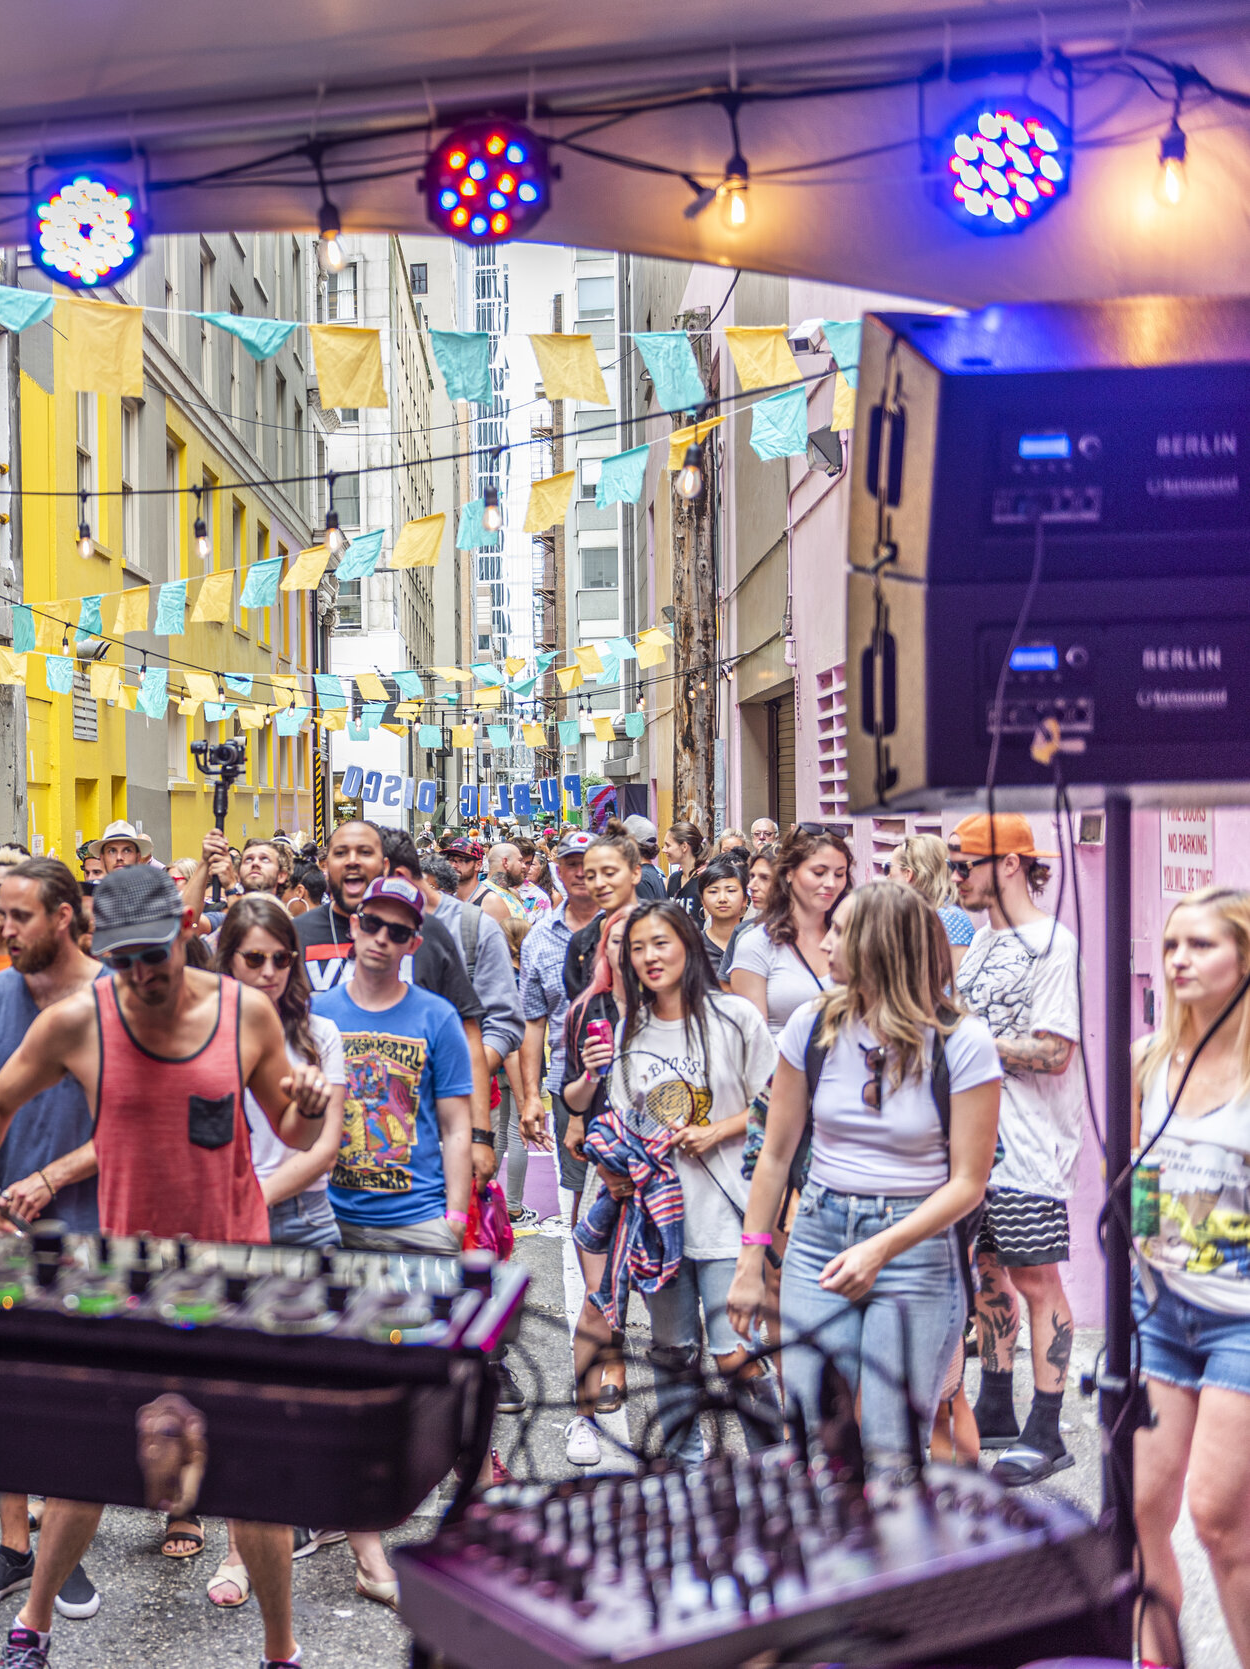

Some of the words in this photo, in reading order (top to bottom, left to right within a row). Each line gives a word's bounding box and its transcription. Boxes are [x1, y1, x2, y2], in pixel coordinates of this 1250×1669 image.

[1156, 433, 1237, 456] BERLIN
[1142, 647, 1221, 670] BERLIN
[1168, 833, 1177, 853] NO
[1179, 834, 1207, 856] PARKING
[1164, 866, 1174, 888] YOU
[1175, 867, 1186, 890] WILL
[1188, 868, 1194, 891] BE
